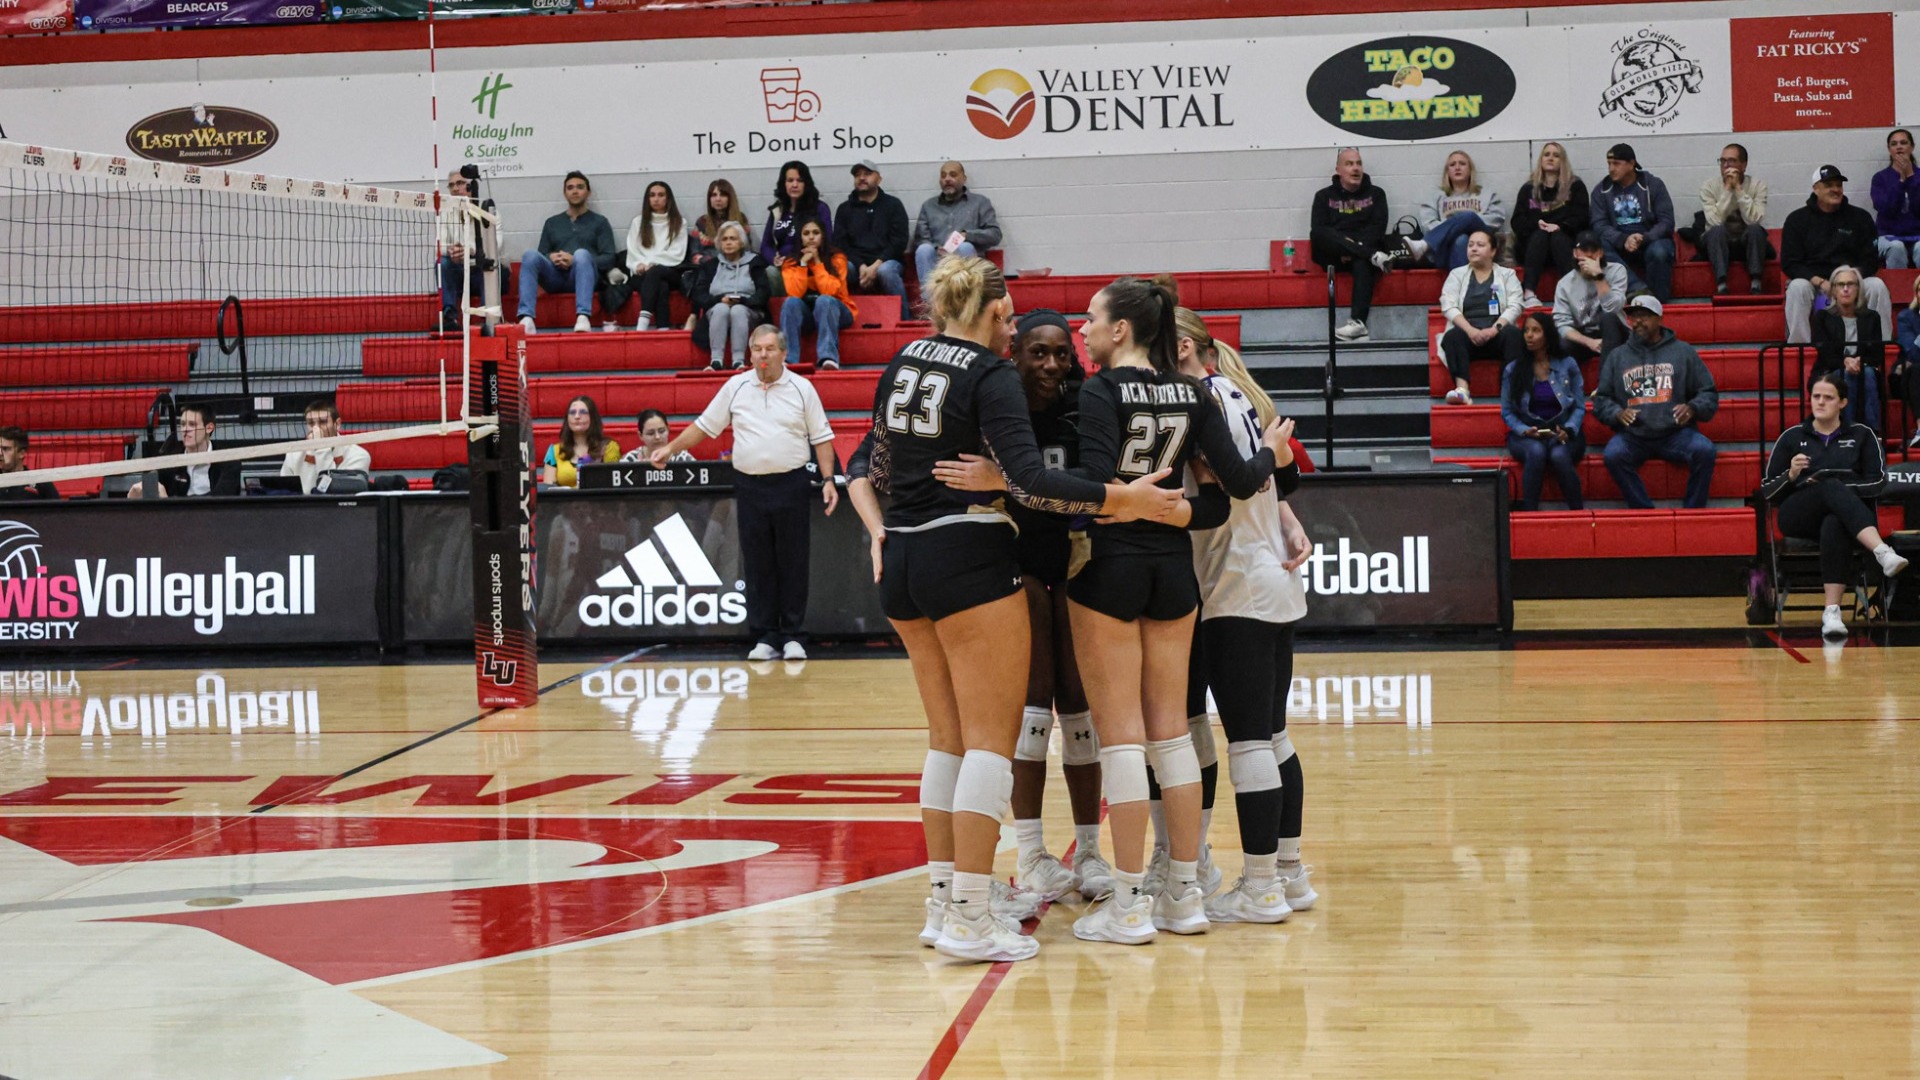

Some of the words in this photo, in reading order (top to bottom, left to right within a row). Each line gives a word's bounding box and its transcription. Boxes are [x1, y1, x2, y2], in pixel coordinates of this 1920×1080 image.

[0, 0, 18, 8] ITY
[167, 2, 229, 13] BEARCATS
[276, 5, 315, 18] GLVC
[30, 17, 66, 29] GLVC
[1610, 36, 1634, 54] The
[1638, 28, 1687, 52] Original
[1788, 28, 1836, 40] Featuring
[1364, 45, 1456, 73] TACO
[1757, 44, 1789, 57] FAT
[1037, 68, 1145, 93] VALLEY
[1150, 64, 1232, 89] VIEW
[1609, 84, 1626, 97] OLD
[1629, 70, 1658, 85] WORLD
[1662, 63, 1689, 74] PIZZA
[1777, 77, 1803, 88] Beef,
[1806, 76, 1849, 88] Burgers,
[1774, 92, 1804, 103] Pasta,
[1806, 91, 1830, 101] Subs
[1833, 90, 1853, 100] and
[1041, 93, 1235, 134] DENTAL
[1340, 94, 1483, 123] HEAVEN
[1619, 112, 1656, 127] Elmwood
[1657, 109, 1680, 128] Park
[1796, 107, 1832, 117] more...
[452, 124, 508, 142] Holiday
[510, 122, 534, 138] Inn
[692, 131, 736, 154] The
[748, 131, 821, 153] Donut
[832, 127, 894, 153] Shop
[178, 150, 223, 158] Romeoville,
[464, 144, 474, 158] &
[477, 144, 518, 158] Suites
[886, 364, 951, 439] 23
[1116, 411, 1190, 477] 27
[645, 469, 674, 486] poss
[519, 440, 533, 612] FLYERS
[489, 553, 502, 595] sports
[578, 584, 747, 628] adidas
[0, 620, 80, 640] ERSITY
[492, 597, 504, 646] imports
[482, 651, 517, 687] LU
